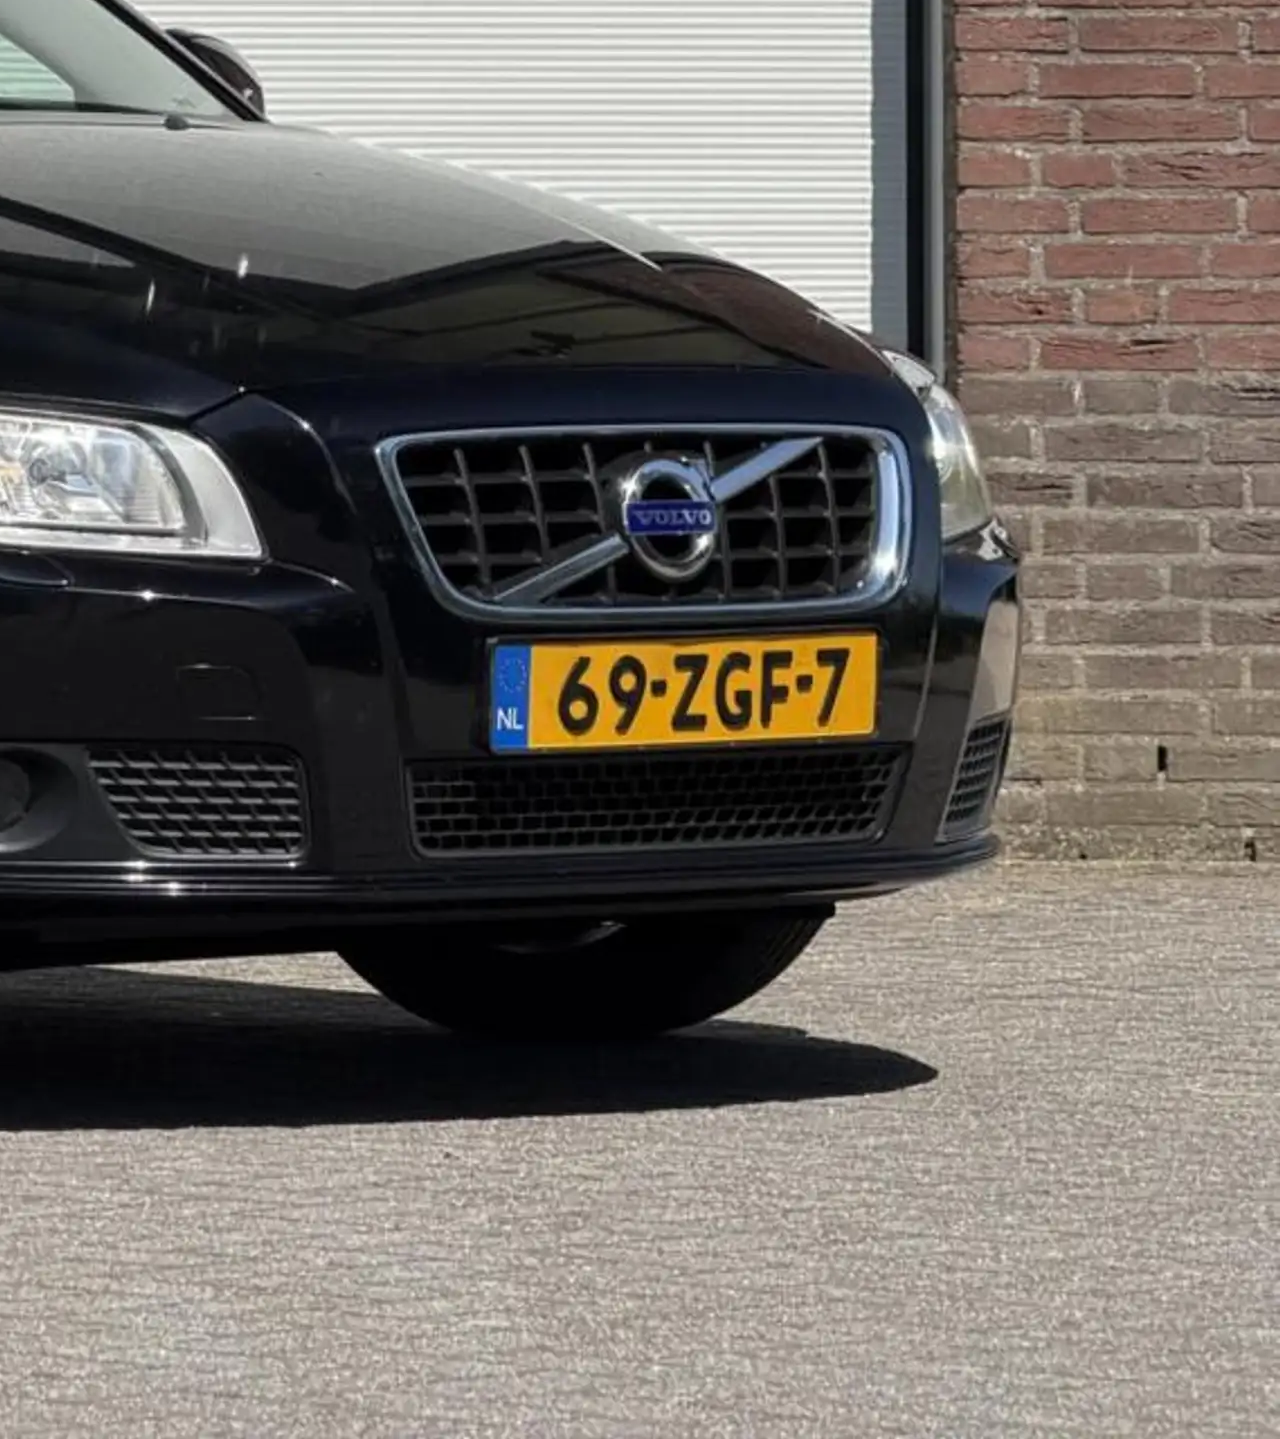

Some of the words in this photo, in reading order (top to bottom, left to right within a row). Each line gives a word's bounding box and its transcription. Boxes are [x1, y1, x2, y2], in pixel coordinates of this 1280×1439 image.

[631, 509, 713, 526] VOLVO
[497, 707, 524, 730] NL
[557, 647, 851, 737] 69-ZGF-7
